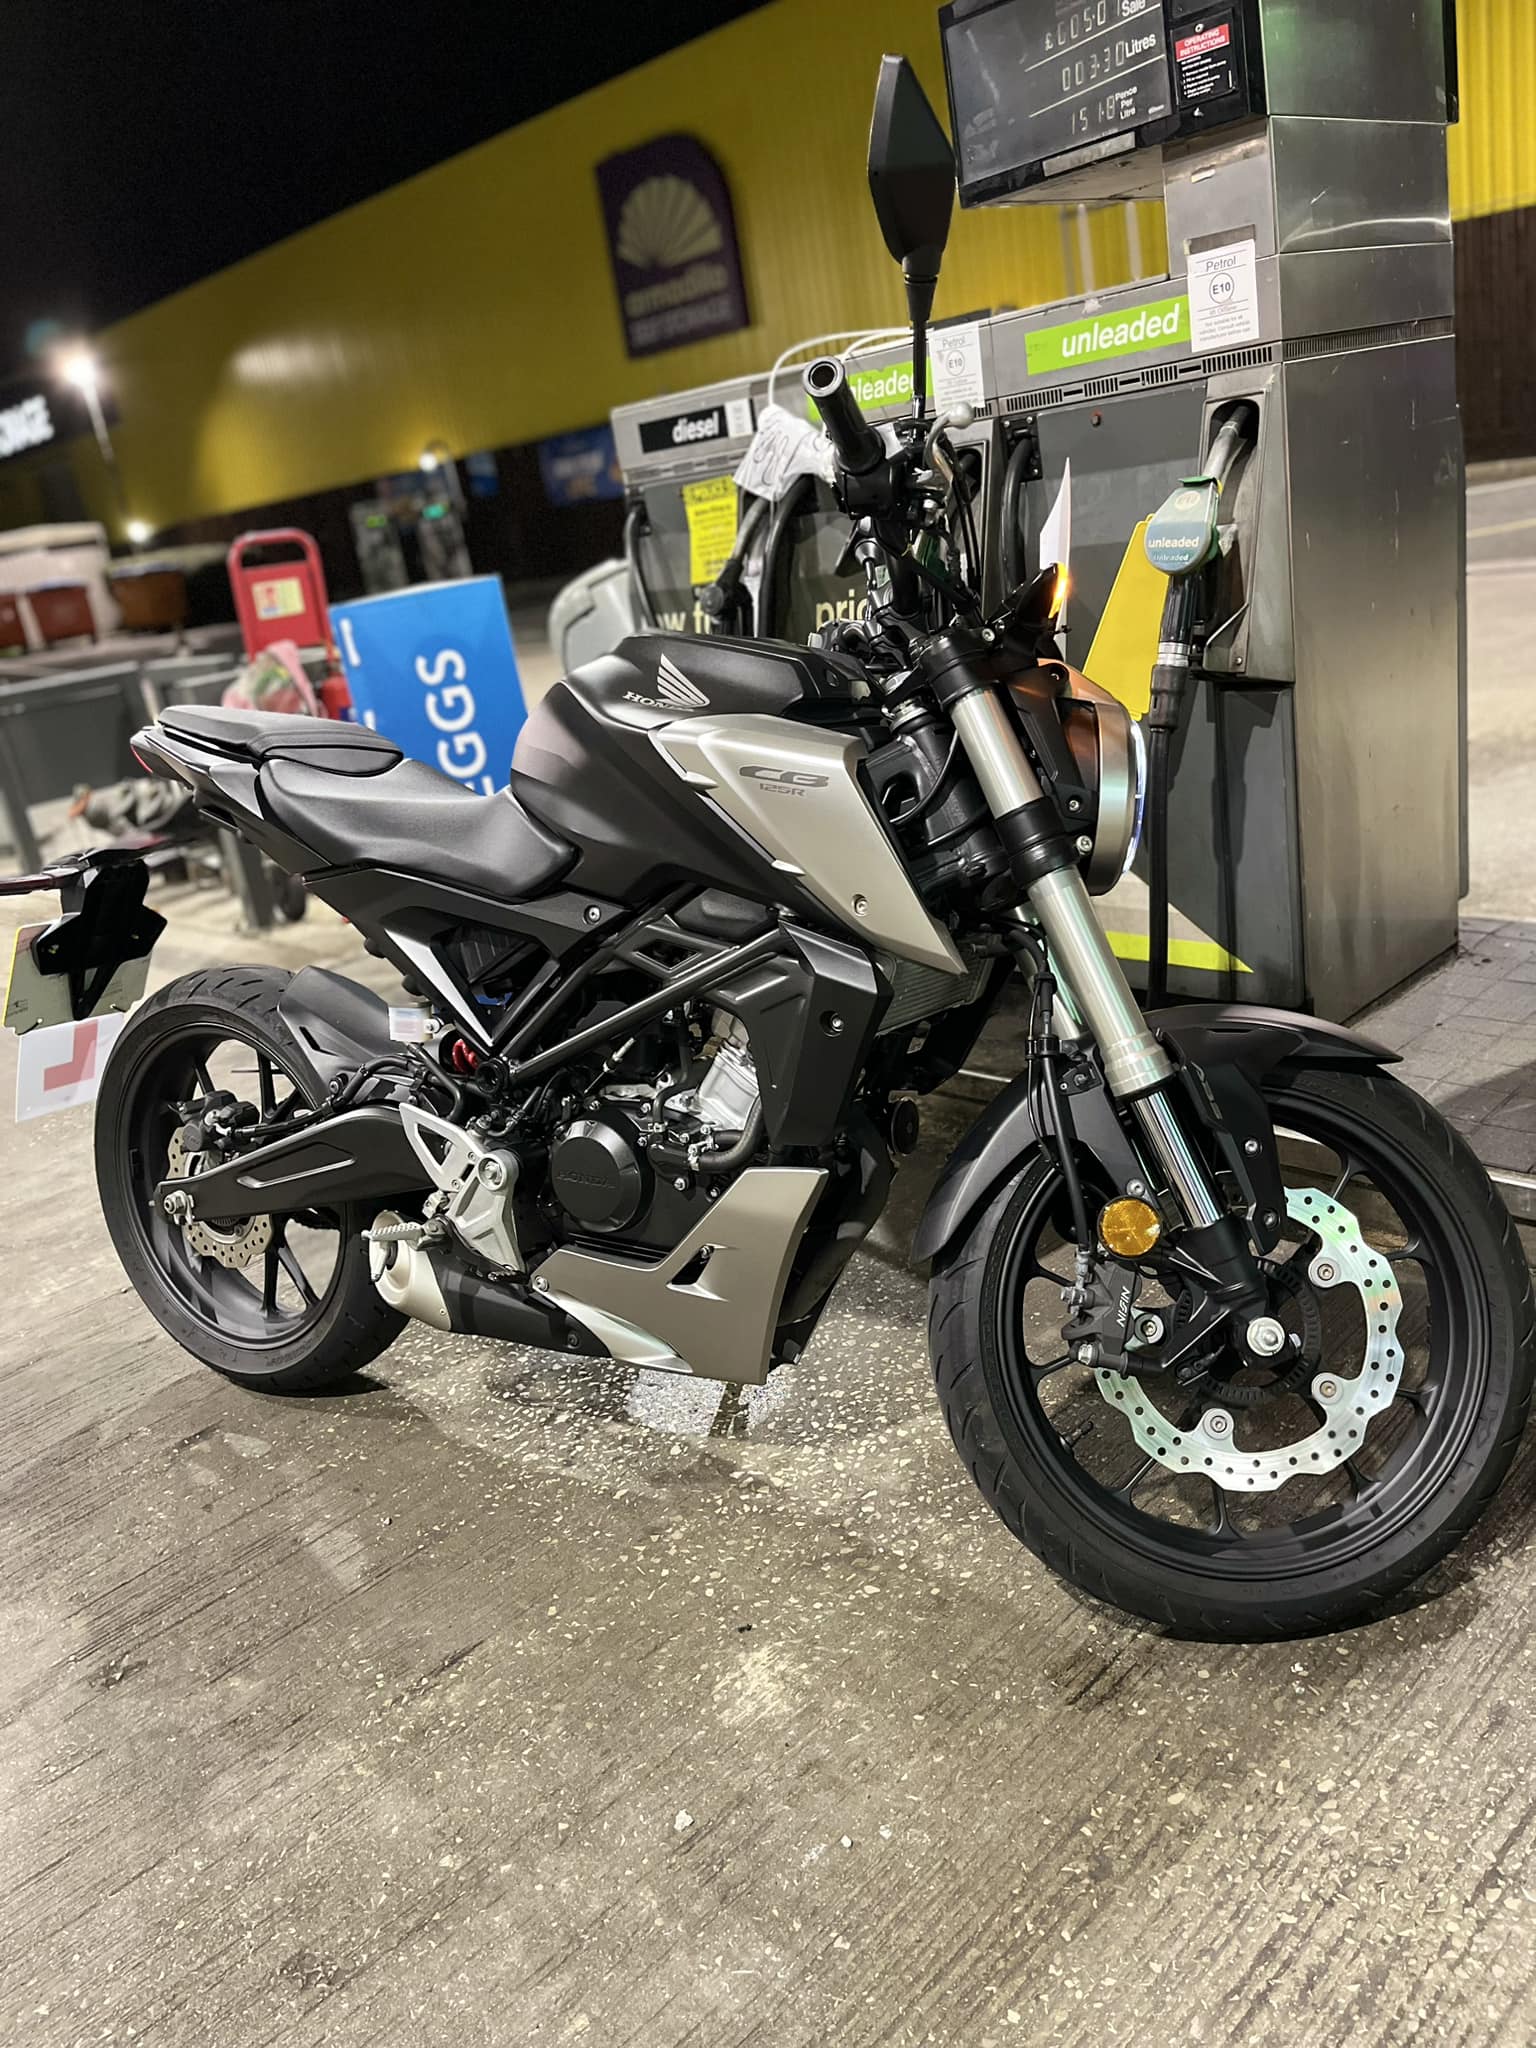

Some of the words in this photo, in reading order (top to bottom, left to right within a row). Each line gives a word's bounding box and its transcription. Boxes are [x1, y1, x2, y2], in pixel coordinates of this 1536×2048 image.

[1125, 34, 1157, 58] Litres
[1180, 35, 1226, 57] INSTRUCTIONS
[1184, 28, 1220, 47] OPERATING
[1114, 86, 1138, 101] Pence
[1120, 98, 1134, 109] Per
[1120, 107, 1137, 120] Litre
[1205, 255, 1237, 273] Petrol
[1212, 281, 1231, 295] E10
[1061, 302, 1180, 358] unleaded
[942, 336, 966, 348] Petrol
[948, 357, 963, 369] E10
[851, 370, 914, 402] leade
[672, 410, 719, 444] diesel
[1148, 536, 1200, 549] unleaded
[415, 649, 495, 797] GGS
[739, 764, 830, 789] CB
[760, 782, 805, 797] 125R
